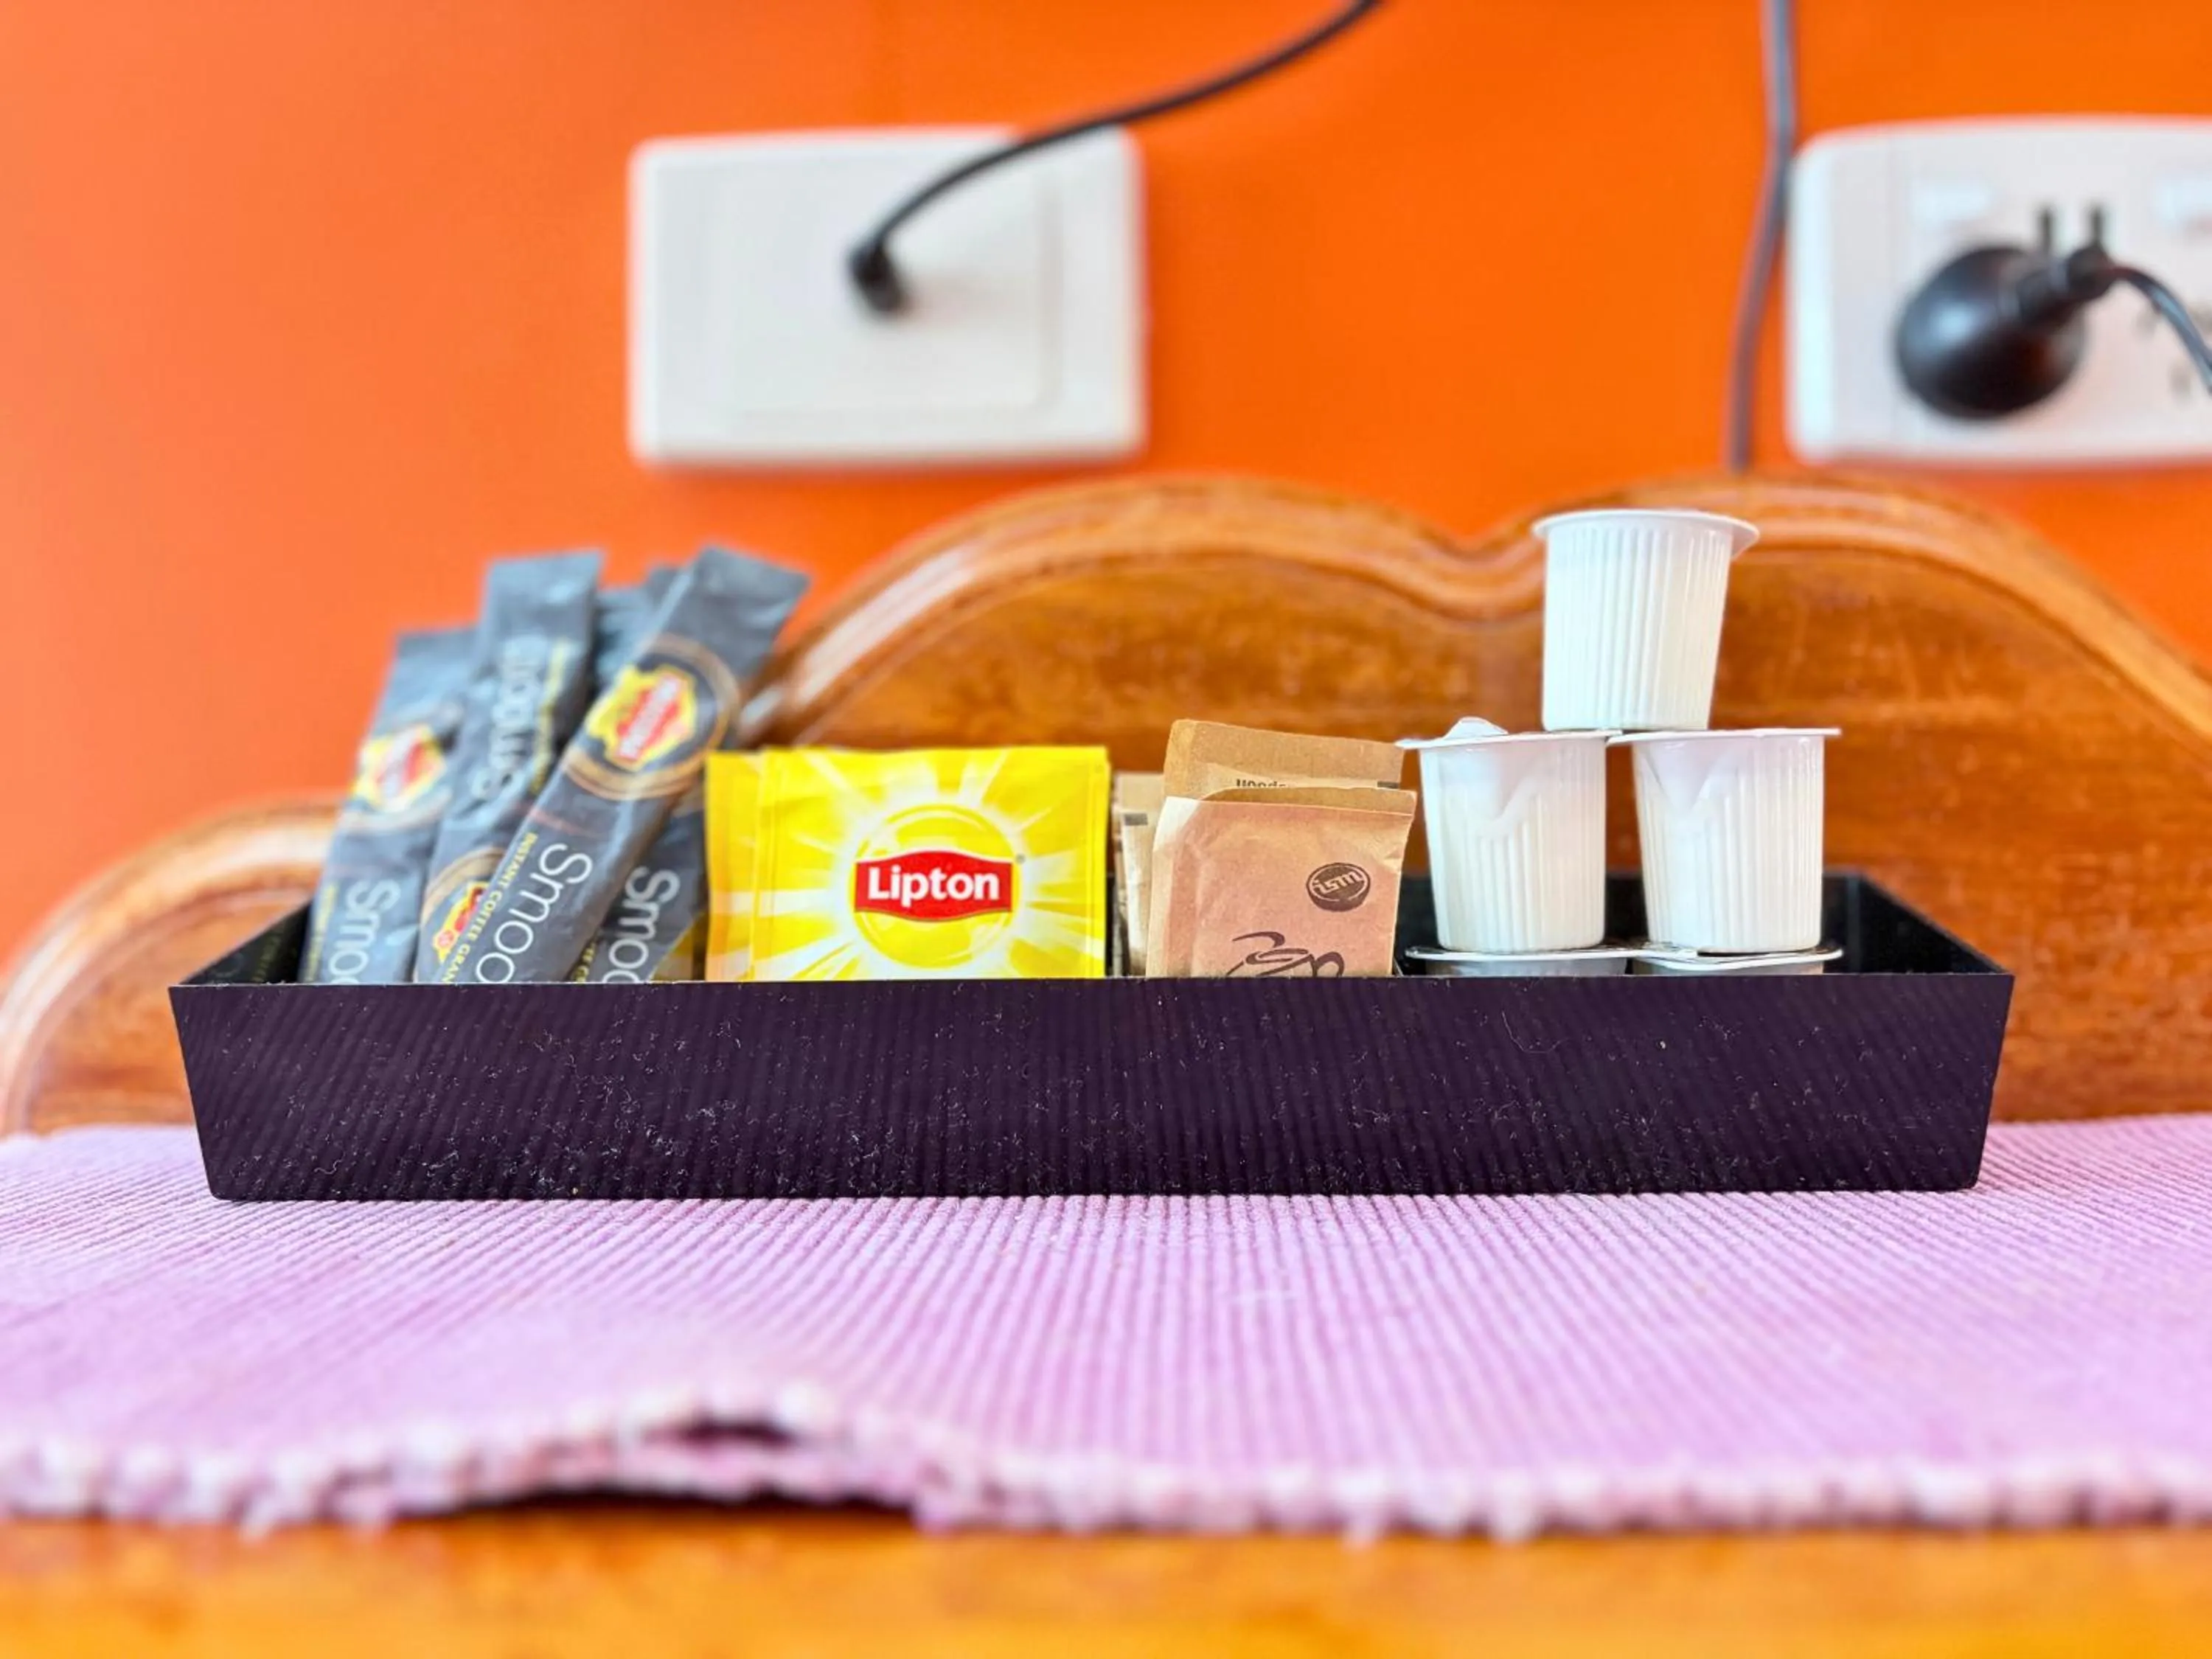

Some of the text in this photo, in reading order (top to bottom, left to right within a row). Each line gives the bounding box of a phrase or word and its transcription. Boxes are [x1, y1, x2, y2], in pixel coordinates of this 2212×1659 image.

[467, 889, 503, 941] COFFEE
[476, 843, 593, 983] Smoo
[868, 864, 1000, 908] Lipton
[329, 879, 402, 983] Smo
